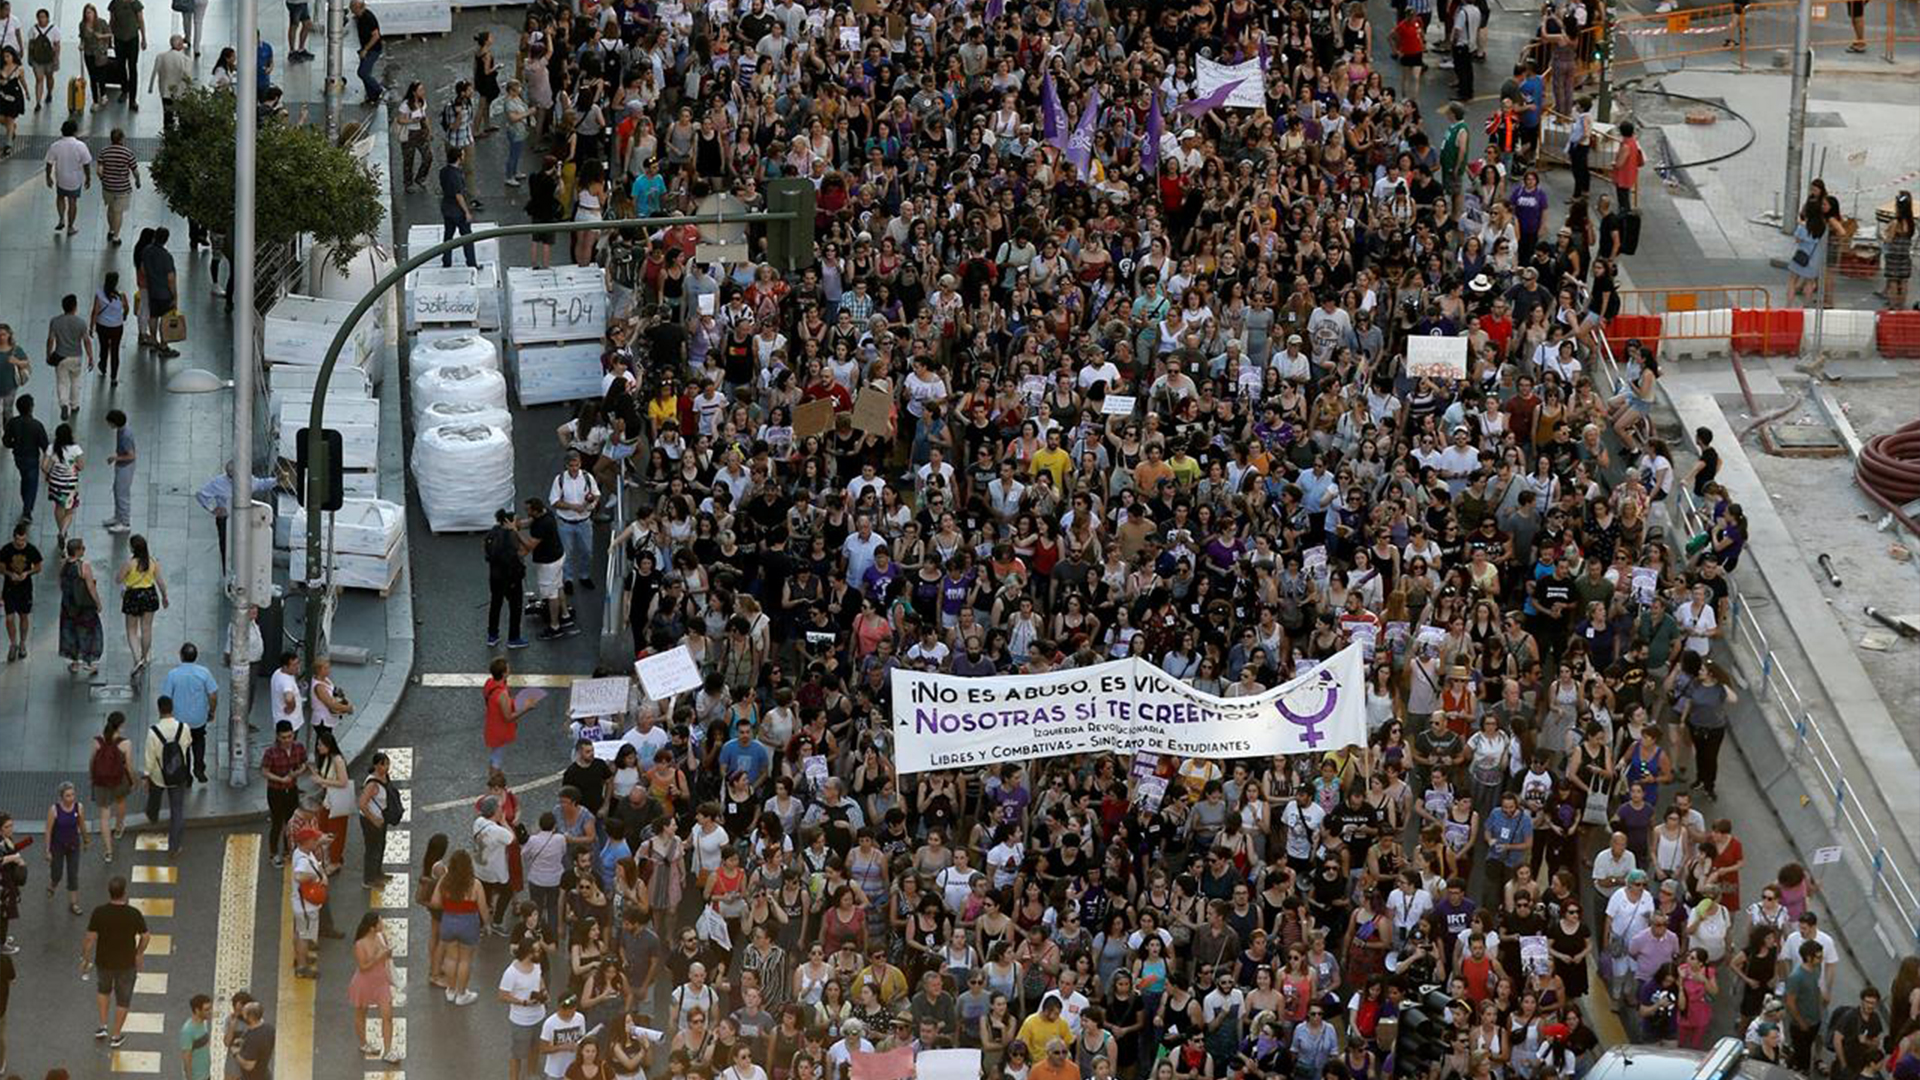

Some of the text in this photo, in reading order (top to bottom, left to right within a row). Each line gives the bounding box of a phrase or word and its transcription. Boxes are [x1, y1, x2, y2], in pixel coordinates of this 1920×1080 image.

[522, 296, 594, 329] T9-04
[968, 688, 995, 703] ES
[1101, 676, 1126, 693] ES
[915, 697, 1259, 734] NOSOTRAS SÍ TE CREEMOS
[1033, 722, 1084, 738] IZQUIERDA
[930, 753, 974, 766] LIBRES
[979, 750, 987, 760] Y
[991, 738, 1073, 759] COMBATIVAS
[1149, 738, 1164, 749] DE
[1167, 739, 1251, 754] ESTUDIANTES
